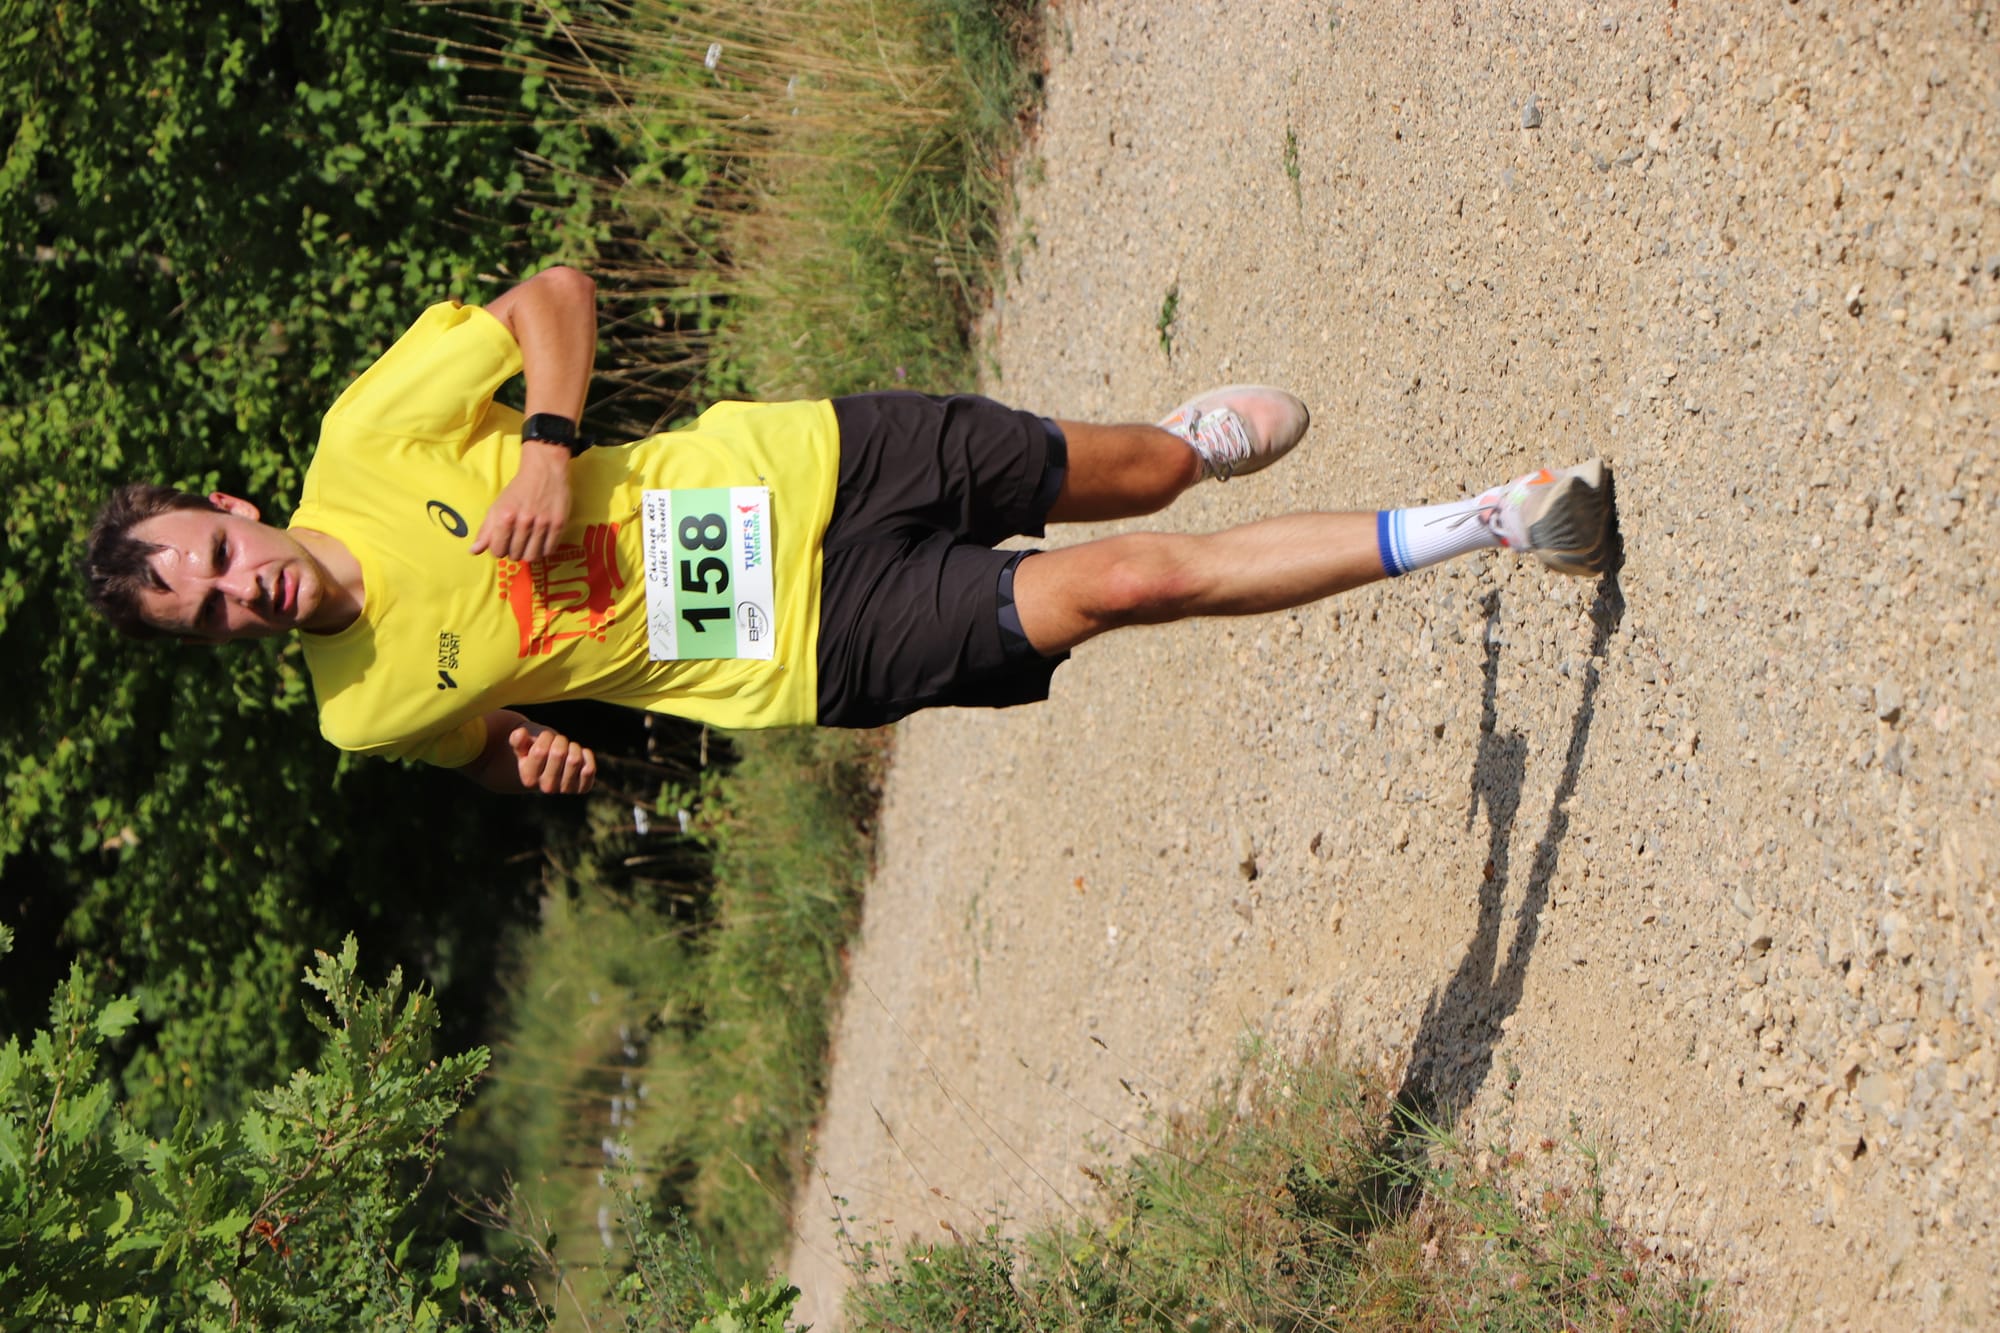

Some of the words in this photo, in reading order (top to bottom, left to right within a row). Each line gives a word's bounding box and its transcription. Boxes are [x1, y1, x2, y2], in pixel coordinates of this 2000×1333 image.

[647, 503, 656, 521] des
[743, 519, 755, 570] TUFF'S
[752, 513, 762, 565] Aventure
[678, 513, 731, 633] 158
[531, 561, 546, 639] MONTPELLIE
[748, 607, 759, 641] BFP
[438, 633, 449, 667] INTER
[449, 633, 460, 669] SPORT
